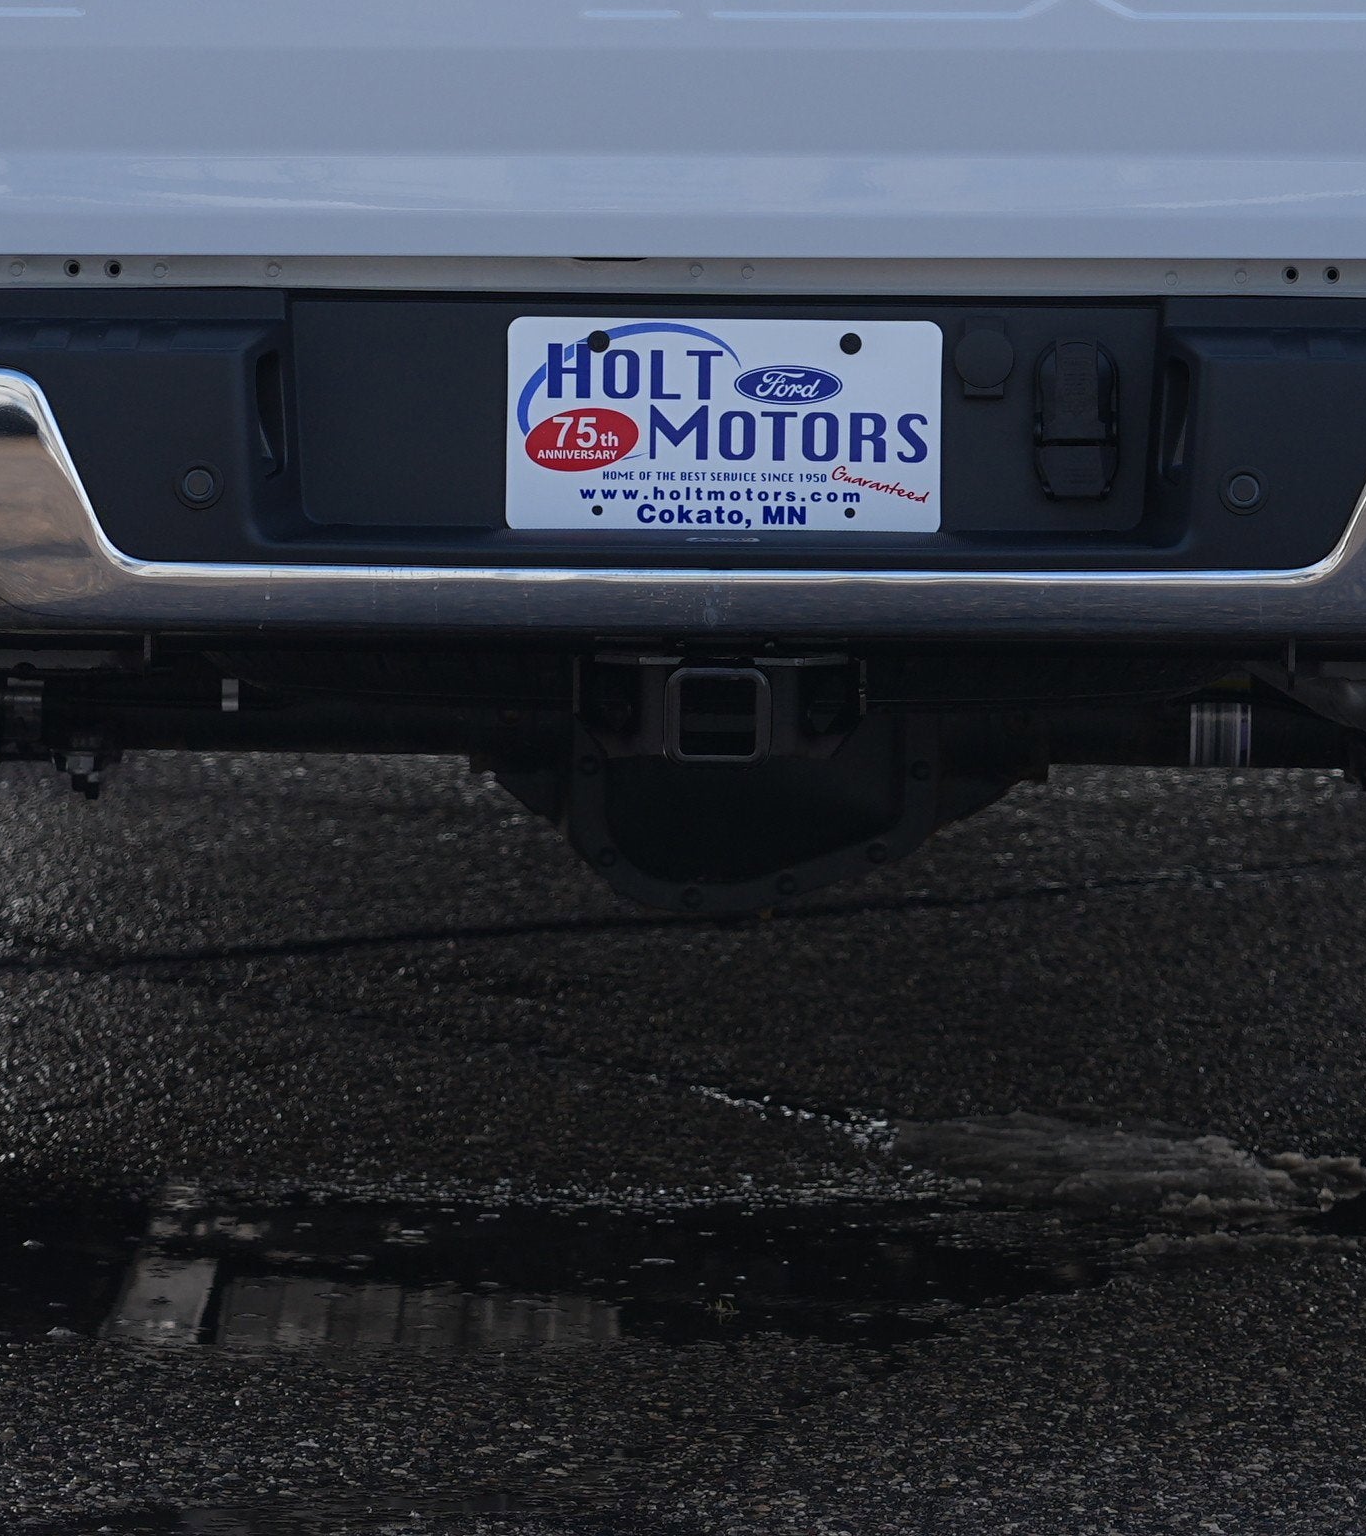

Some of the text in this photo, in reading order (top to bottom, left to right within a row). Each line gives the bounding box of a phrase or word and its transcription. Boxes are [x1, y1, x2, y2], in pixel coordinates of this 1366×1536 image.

[547, 343, 724, 400] HOLT
[755, 371, 822, 398] Ford
[552, 416, 619, 448] 75th
[649, 404, 929, 463] MOTORS
[537, 449, 618, 461] ANNIVERSARY
[602, 471, 828, 483] HOME OF THE BEST SERVICE SINCE 1950
[831, 466, 929, 504] Guaranteed
[580, 485, 861, 503] www.holtmotors.com
[636, 503, 807, 529] Cokato, MN
